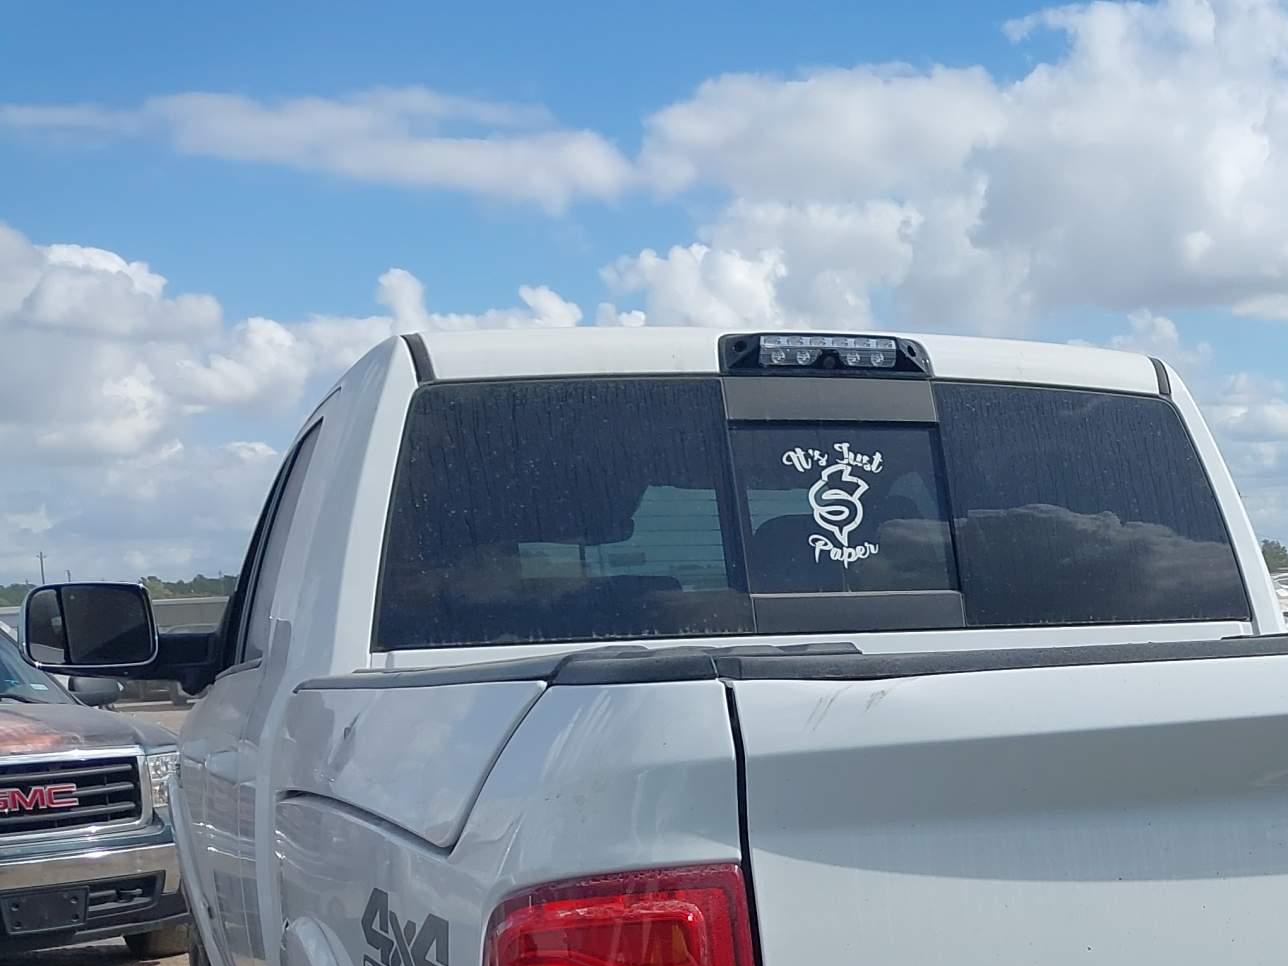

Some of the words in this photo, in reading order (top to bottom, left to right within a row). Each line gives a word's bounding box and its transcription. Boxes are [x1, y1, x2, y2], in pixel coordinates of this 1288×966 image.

[782, 447, 828, 473] It's
[834, 443, 883, 474] Just
[808, 534, 879, 568] Paper
